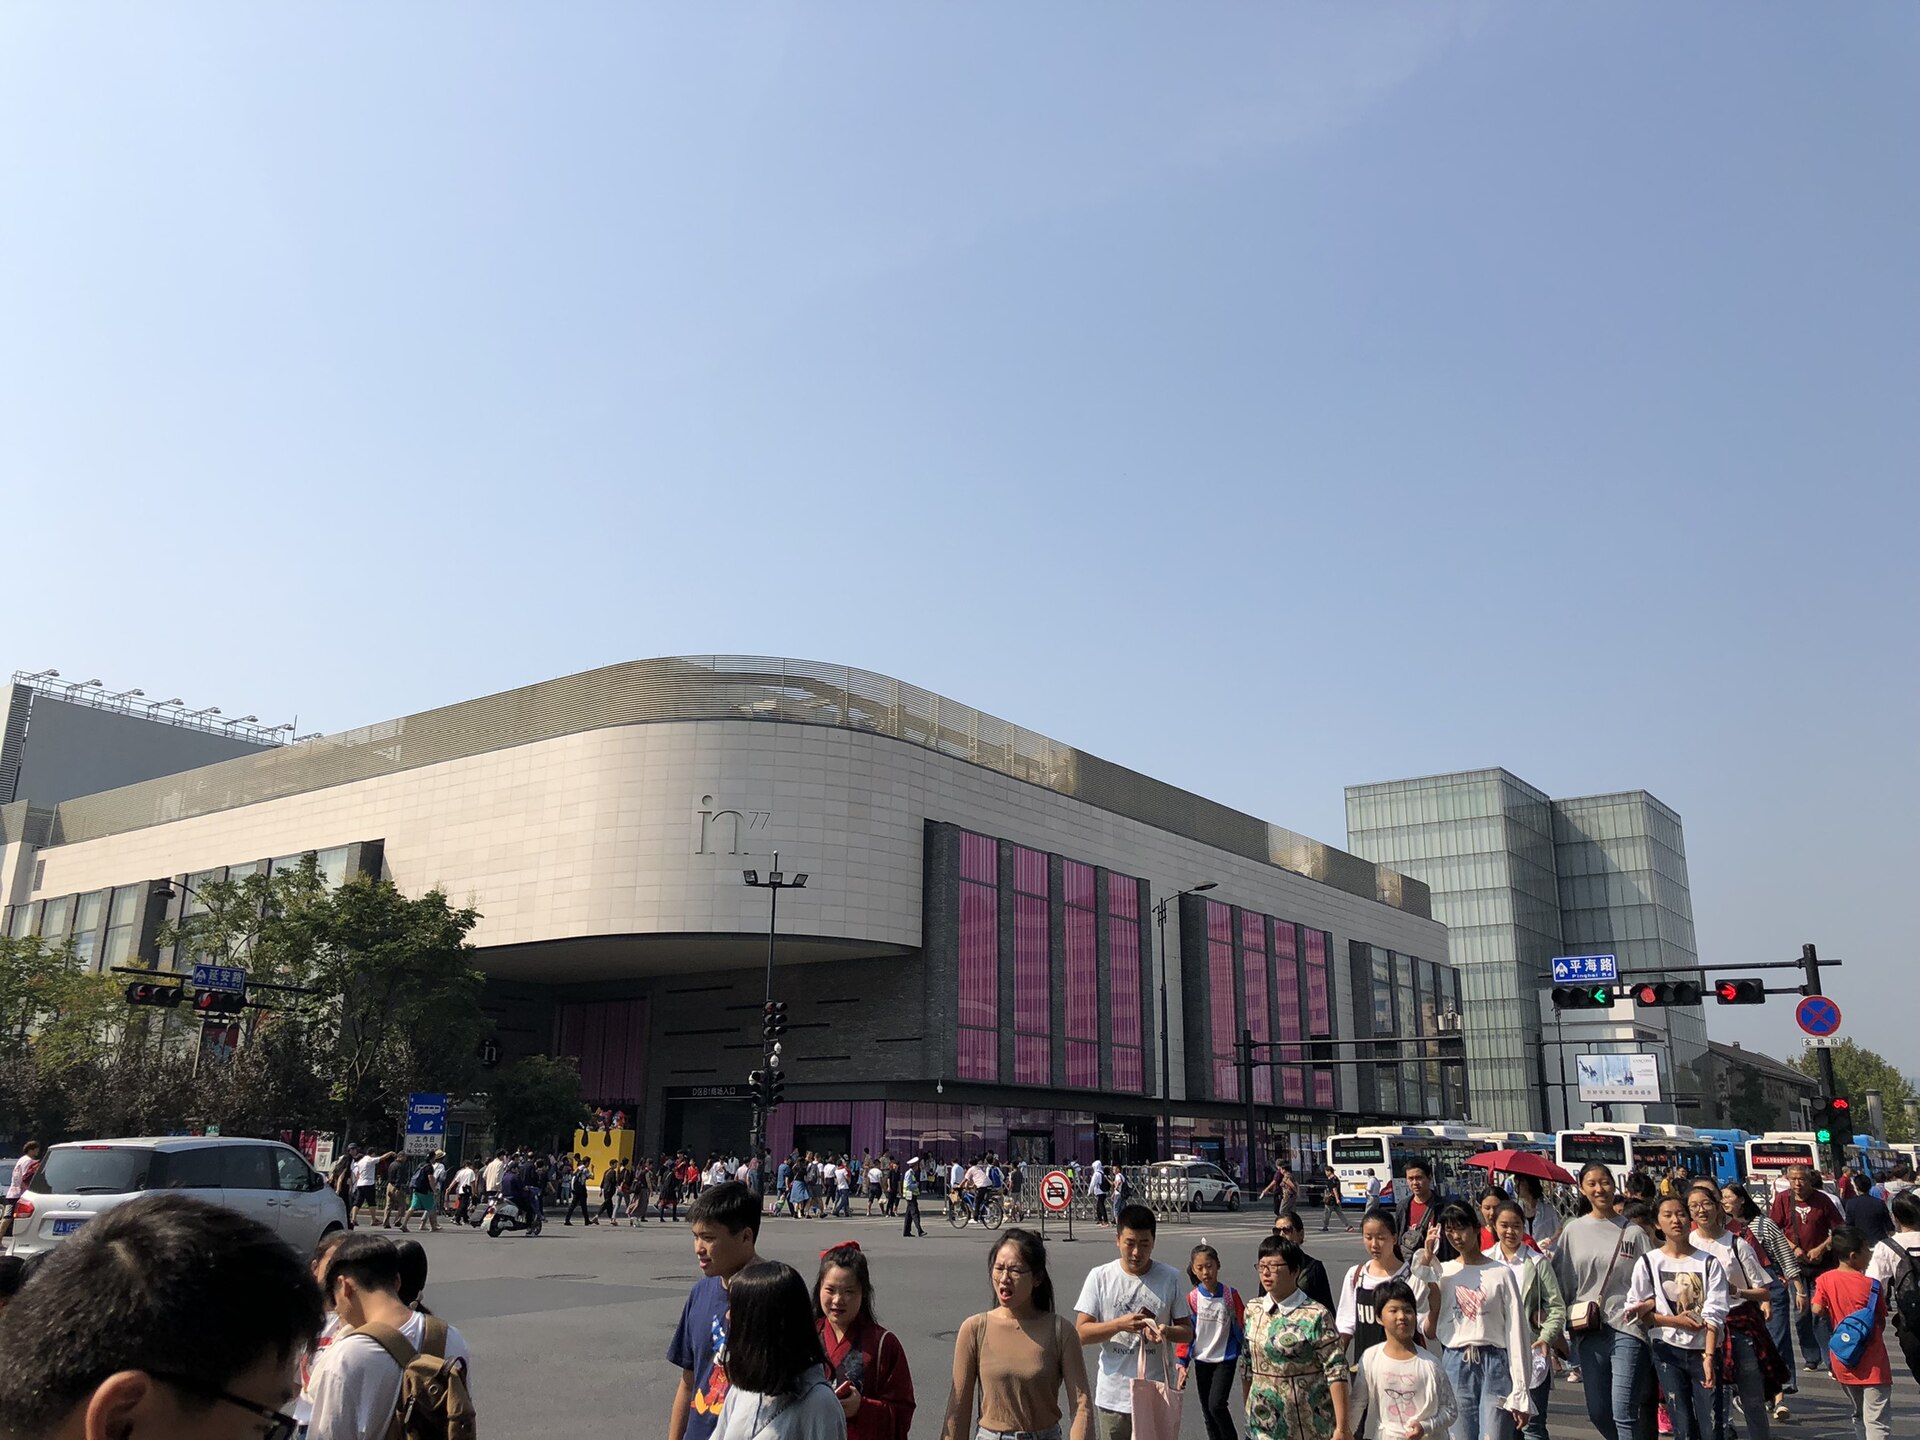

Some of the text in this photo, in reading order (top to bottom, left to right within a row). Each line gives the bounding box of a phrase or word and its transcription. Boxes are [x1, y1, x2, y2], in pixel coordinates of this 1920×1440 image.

[1570, 958, 1612, 973] 平海路
[208, 969, 242, 983] 延安路
[1357, 1303, 1375, 1325] HU
